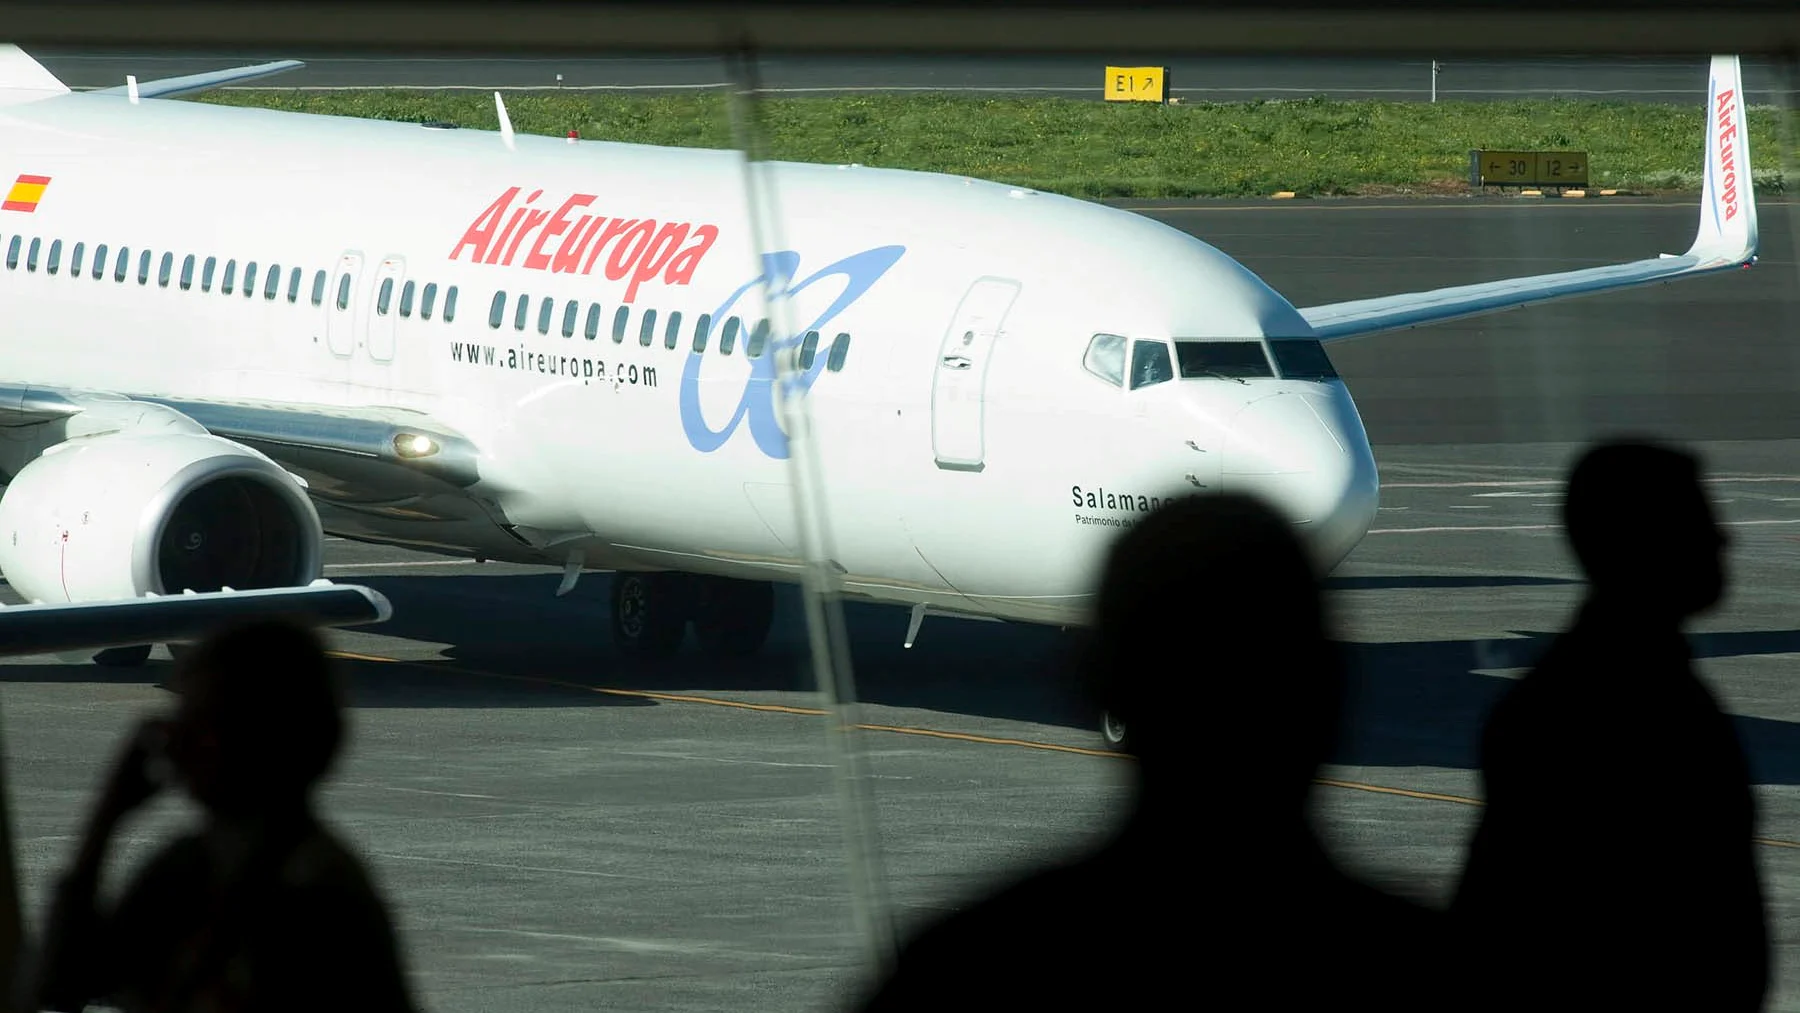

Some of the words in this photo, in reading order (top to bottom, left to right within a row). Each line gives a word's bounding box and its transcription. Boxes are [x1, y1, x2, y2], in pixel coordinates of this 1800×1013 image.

[1116, 75, 1133, 92] E1
[1508, 160, 1526, 176] 30
[1546, 160, 1561, 176] 12
[1716, 89, 1738, 221] AirEuropa
[448, 186, 719, 304] AirEuropa
[450, 340, 658, 388] www.aireuropa.com
[1075, 514, 1120, 528] Patrimonio
